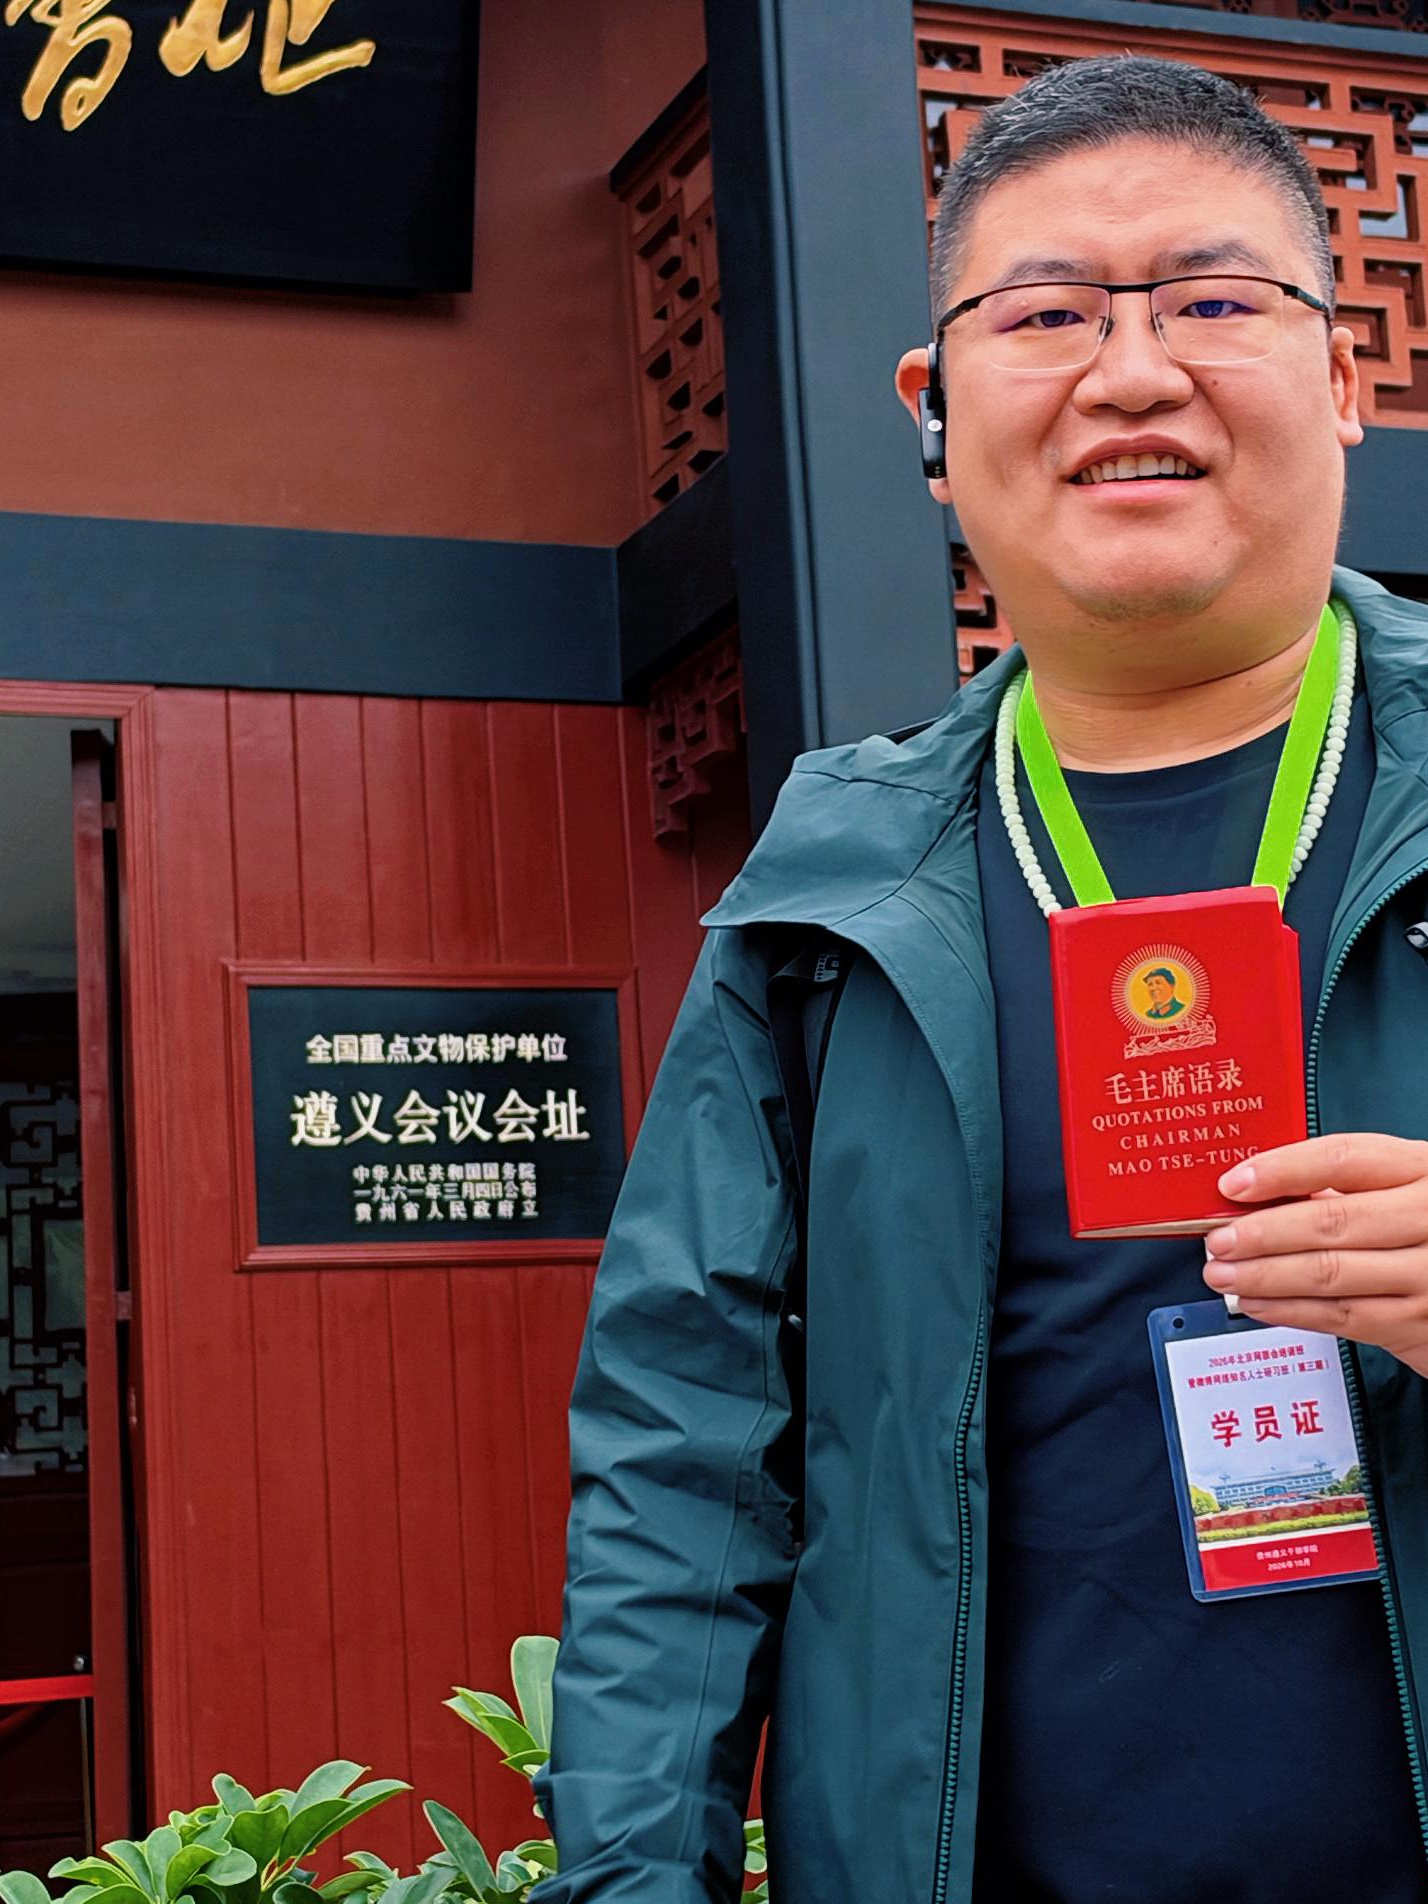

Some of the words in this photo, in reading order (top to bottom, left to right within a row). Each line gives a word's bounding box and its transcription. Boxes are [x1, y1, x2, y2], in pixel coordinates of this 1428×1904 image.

[305, 1033, 568, 1064] 全国重点文物保护单位
[1104, 1058, 1243, 1105] 毛主席语录
[289, 1088, 590, 1147] 遵义会议会址
[1092, 1104, 1207, 1132] QUOTATIONS
[1212, 1096, 1263, 1115] FROM
[1120, 1123, 1241, 1150] CHAIRMAN
[352, 1162, 537, 1183] 中华人民共和国国务院
[1108, 1158, 1153, 1176] MAO
[352, 1181, 538, 1202] 一九六一年三月四日公布
[355, 1199, 539, 1223] 贵州省人民政府立
[1211, 1401, 1323, 1447] 学员证
